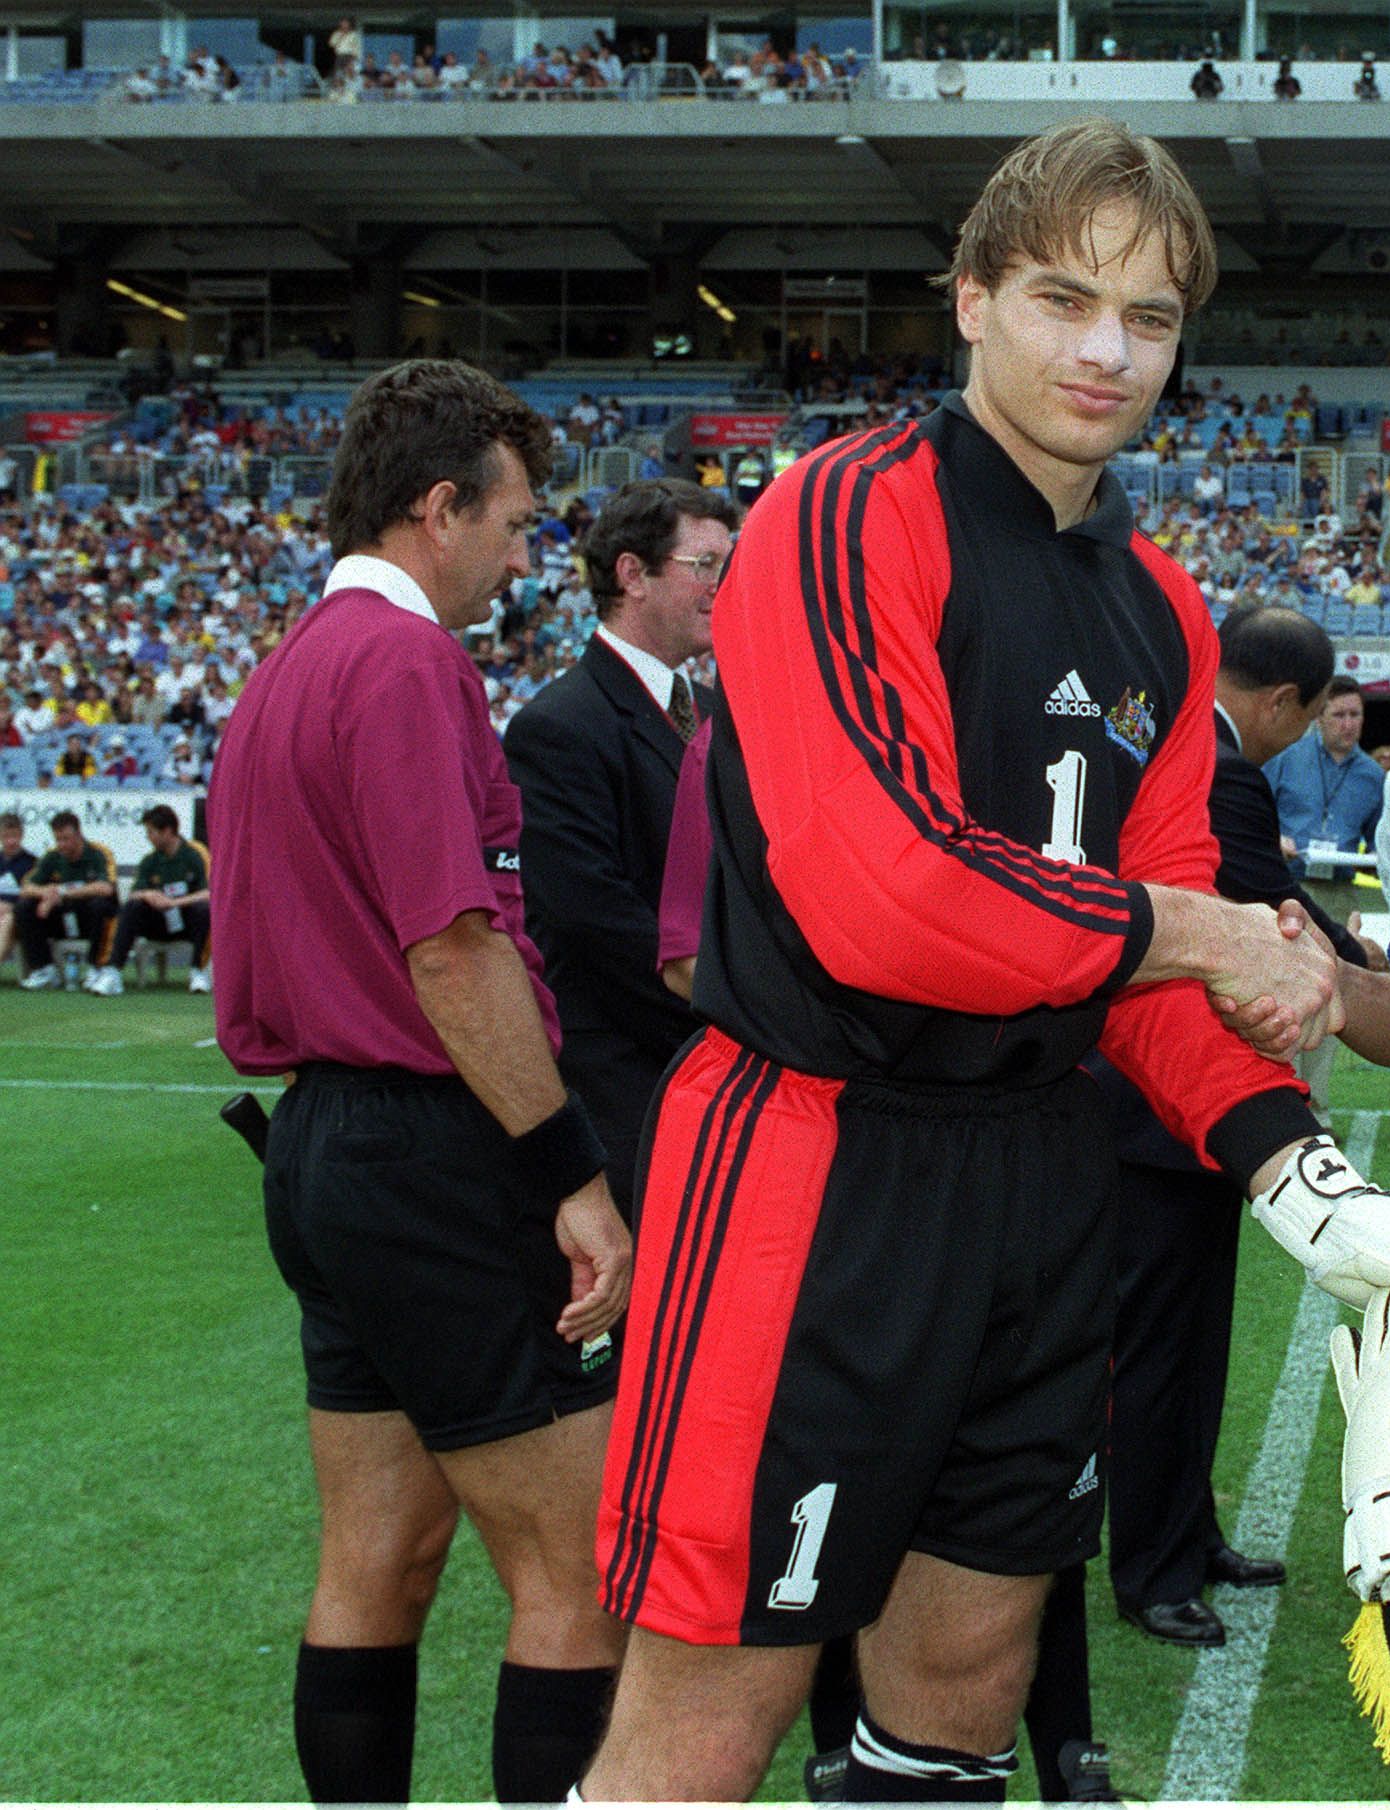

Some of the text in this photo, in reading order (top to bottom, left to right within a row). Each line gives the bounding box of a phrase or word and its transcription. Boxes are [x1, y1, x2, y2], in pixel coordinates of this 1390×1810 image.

[1044, 700, 1101, 718] adidas
[1042, 750, 1087, 866] 1
[767, 1482, 838, 1610] 1
